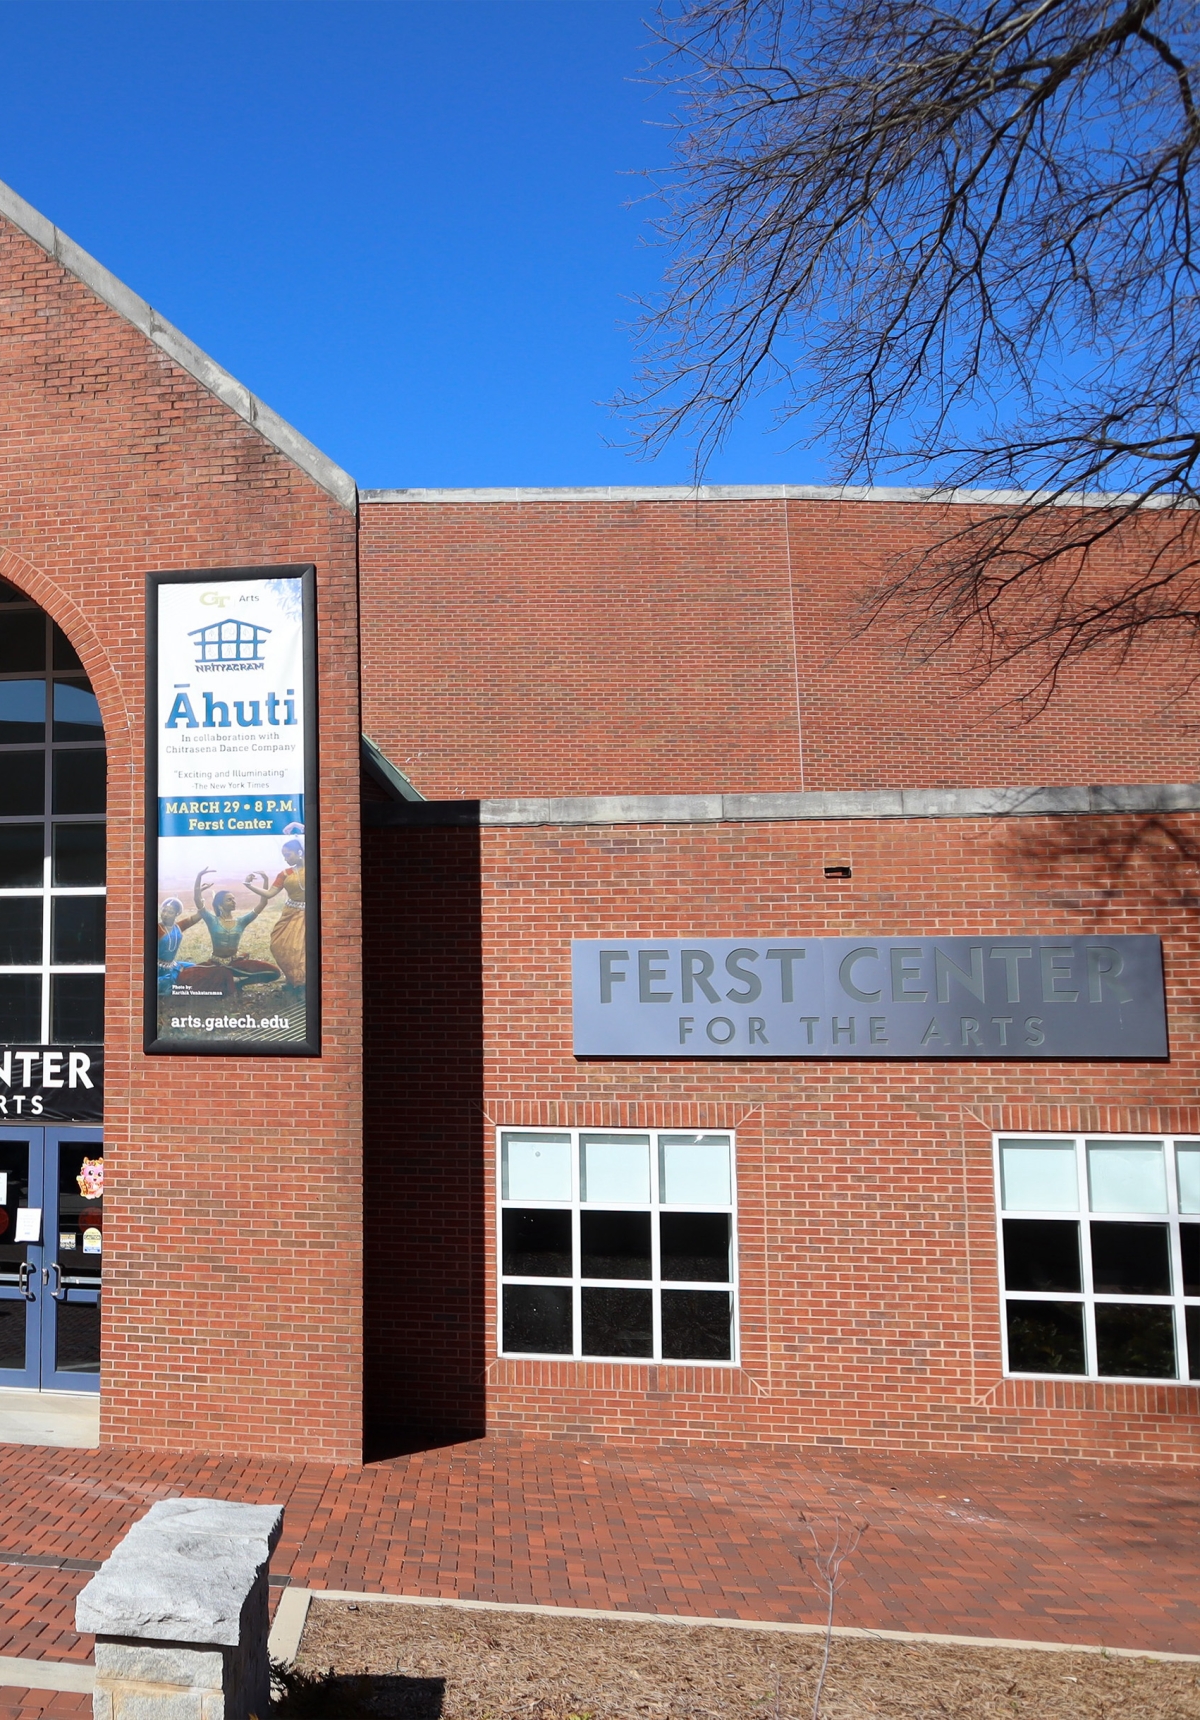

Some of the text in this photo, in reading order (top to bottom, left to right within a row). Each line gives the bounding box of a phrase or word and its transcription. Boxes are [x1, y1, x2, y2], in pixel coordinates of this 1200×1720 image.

[164, 684, 298, 729] Āhuti
[181, 732, 280, 742] In collaboration with
[165, 743, 296, 754] Chitrasena Dance Company
[214, 770, 230, 778] and
[166, 800, 297, 814] MARCH 29 8 P.M.
[189, 818, 273, 831] Ferst Center
[599, 945, 1133, 1006] FERST CENTER
[171, 1014, 290, 1031] arts.gatech.edu
[679, 1016, 1046, 1047] FOR THE ARTS
